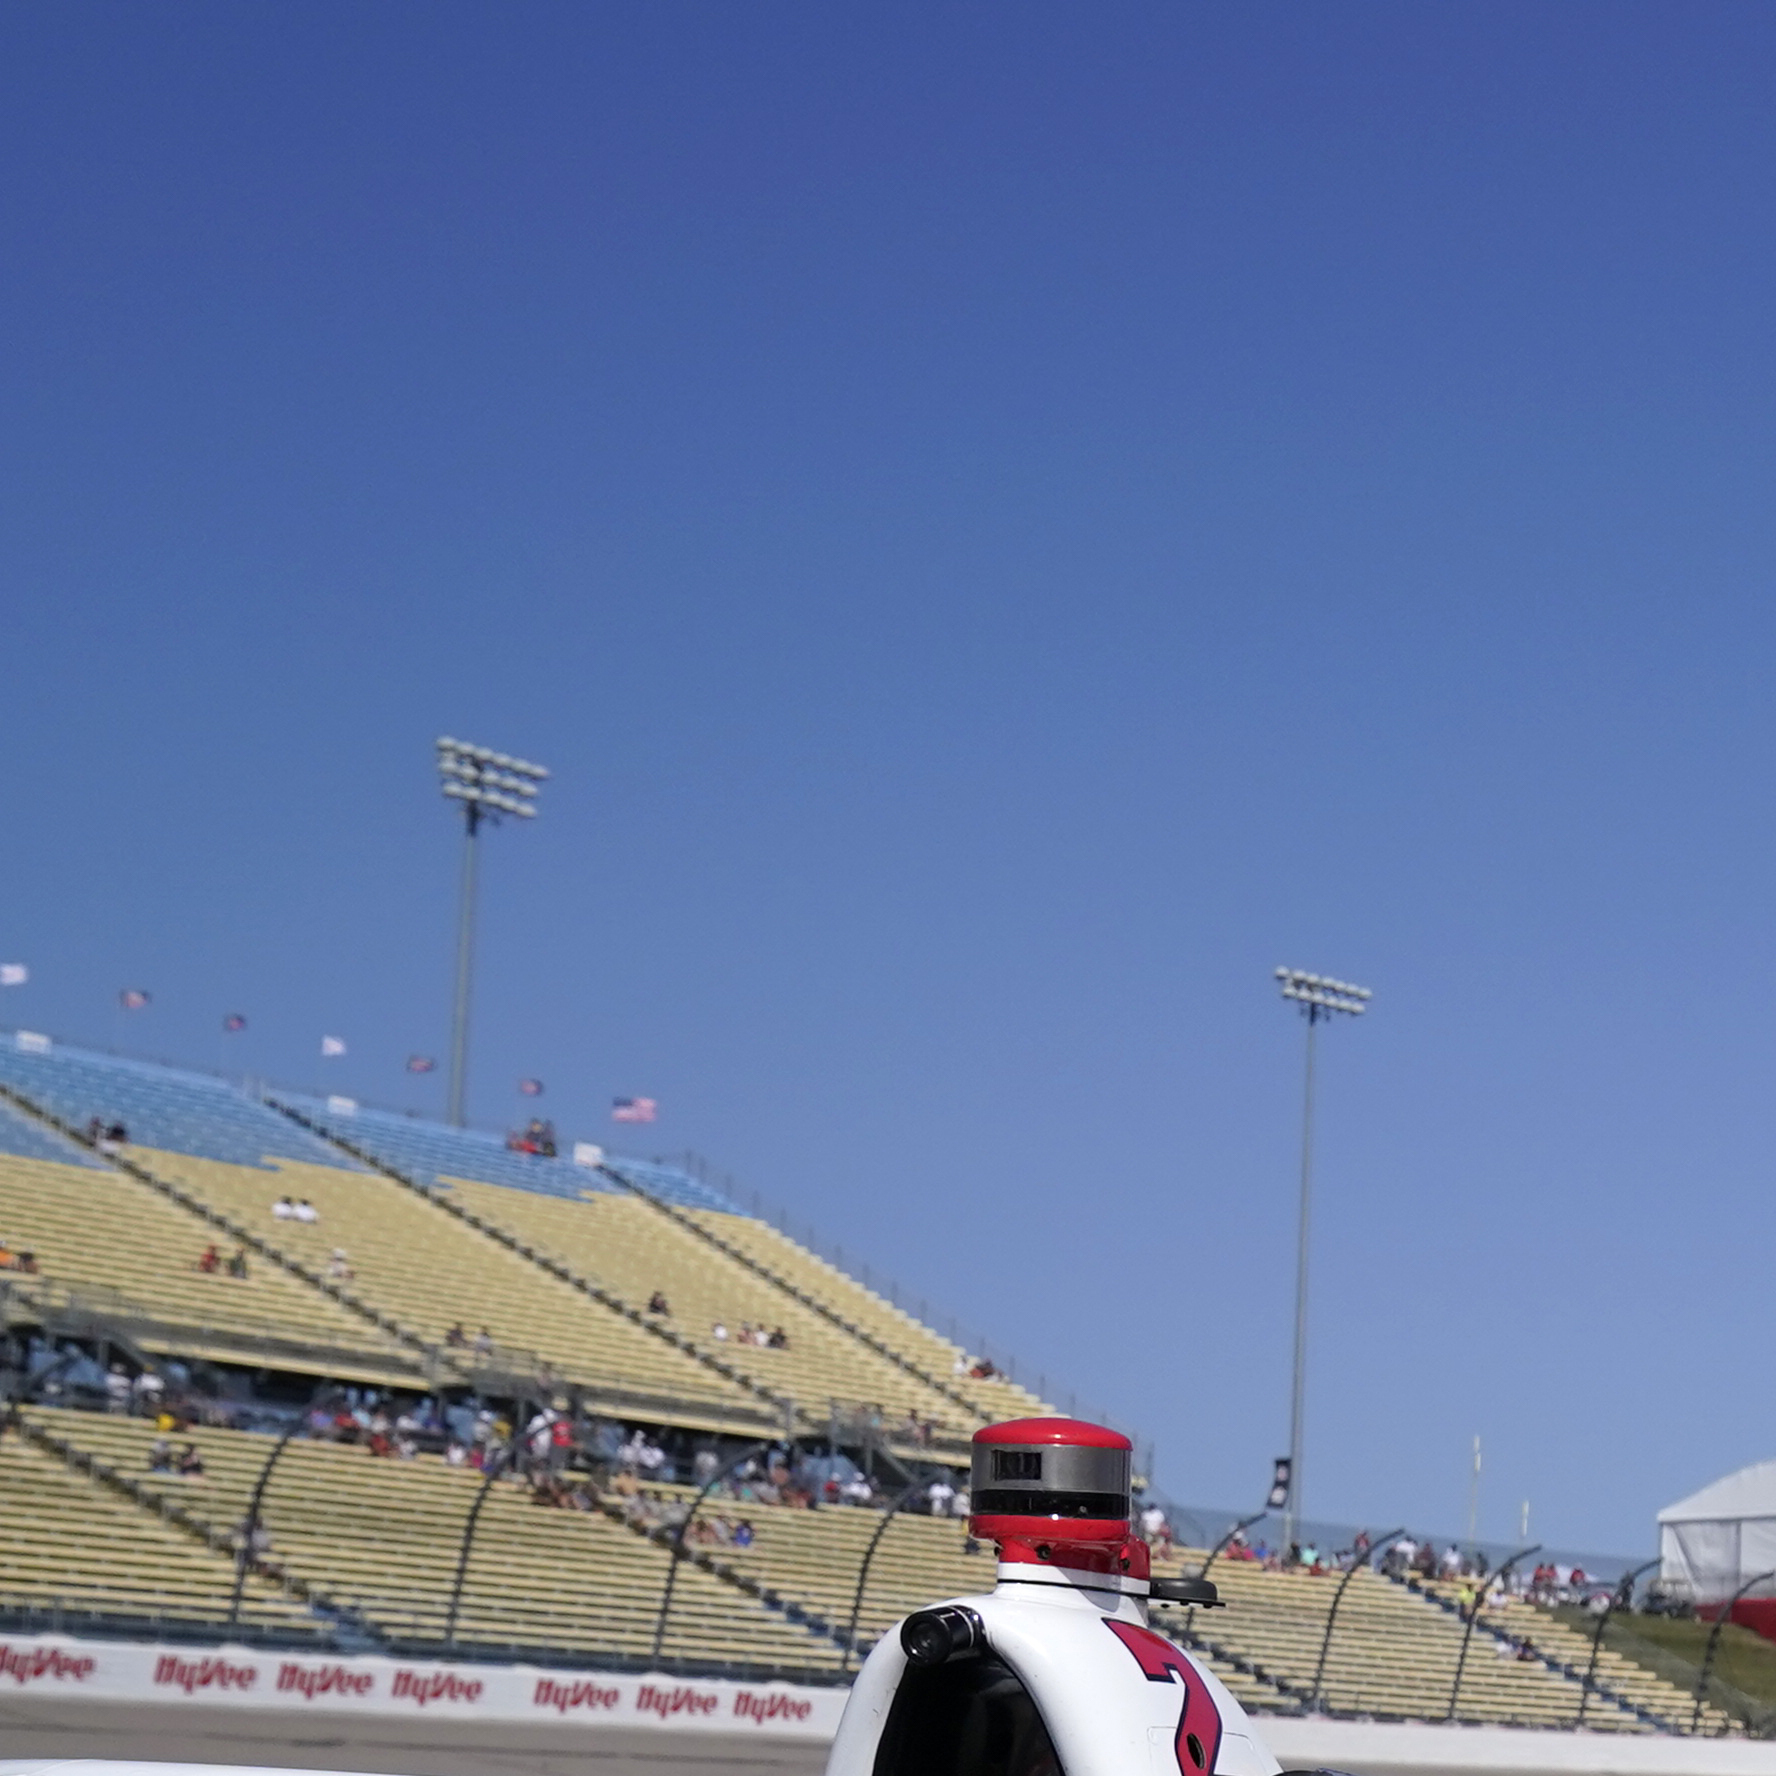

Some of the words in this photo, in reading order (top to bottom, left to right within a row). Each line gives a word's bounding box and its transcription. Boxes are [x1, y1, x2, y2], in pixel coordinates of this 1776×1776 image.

[153, 1653, 259, 1695] HyVee
[276, 1660, 374, 1700] HyVee
[391, 1670, 483, 1707] HyVee
[533, 1677, 621, 1714] HyVee
[634, 1684, 719, 1720] HyVee
[733, 1688, 813, 1725] HyVee
